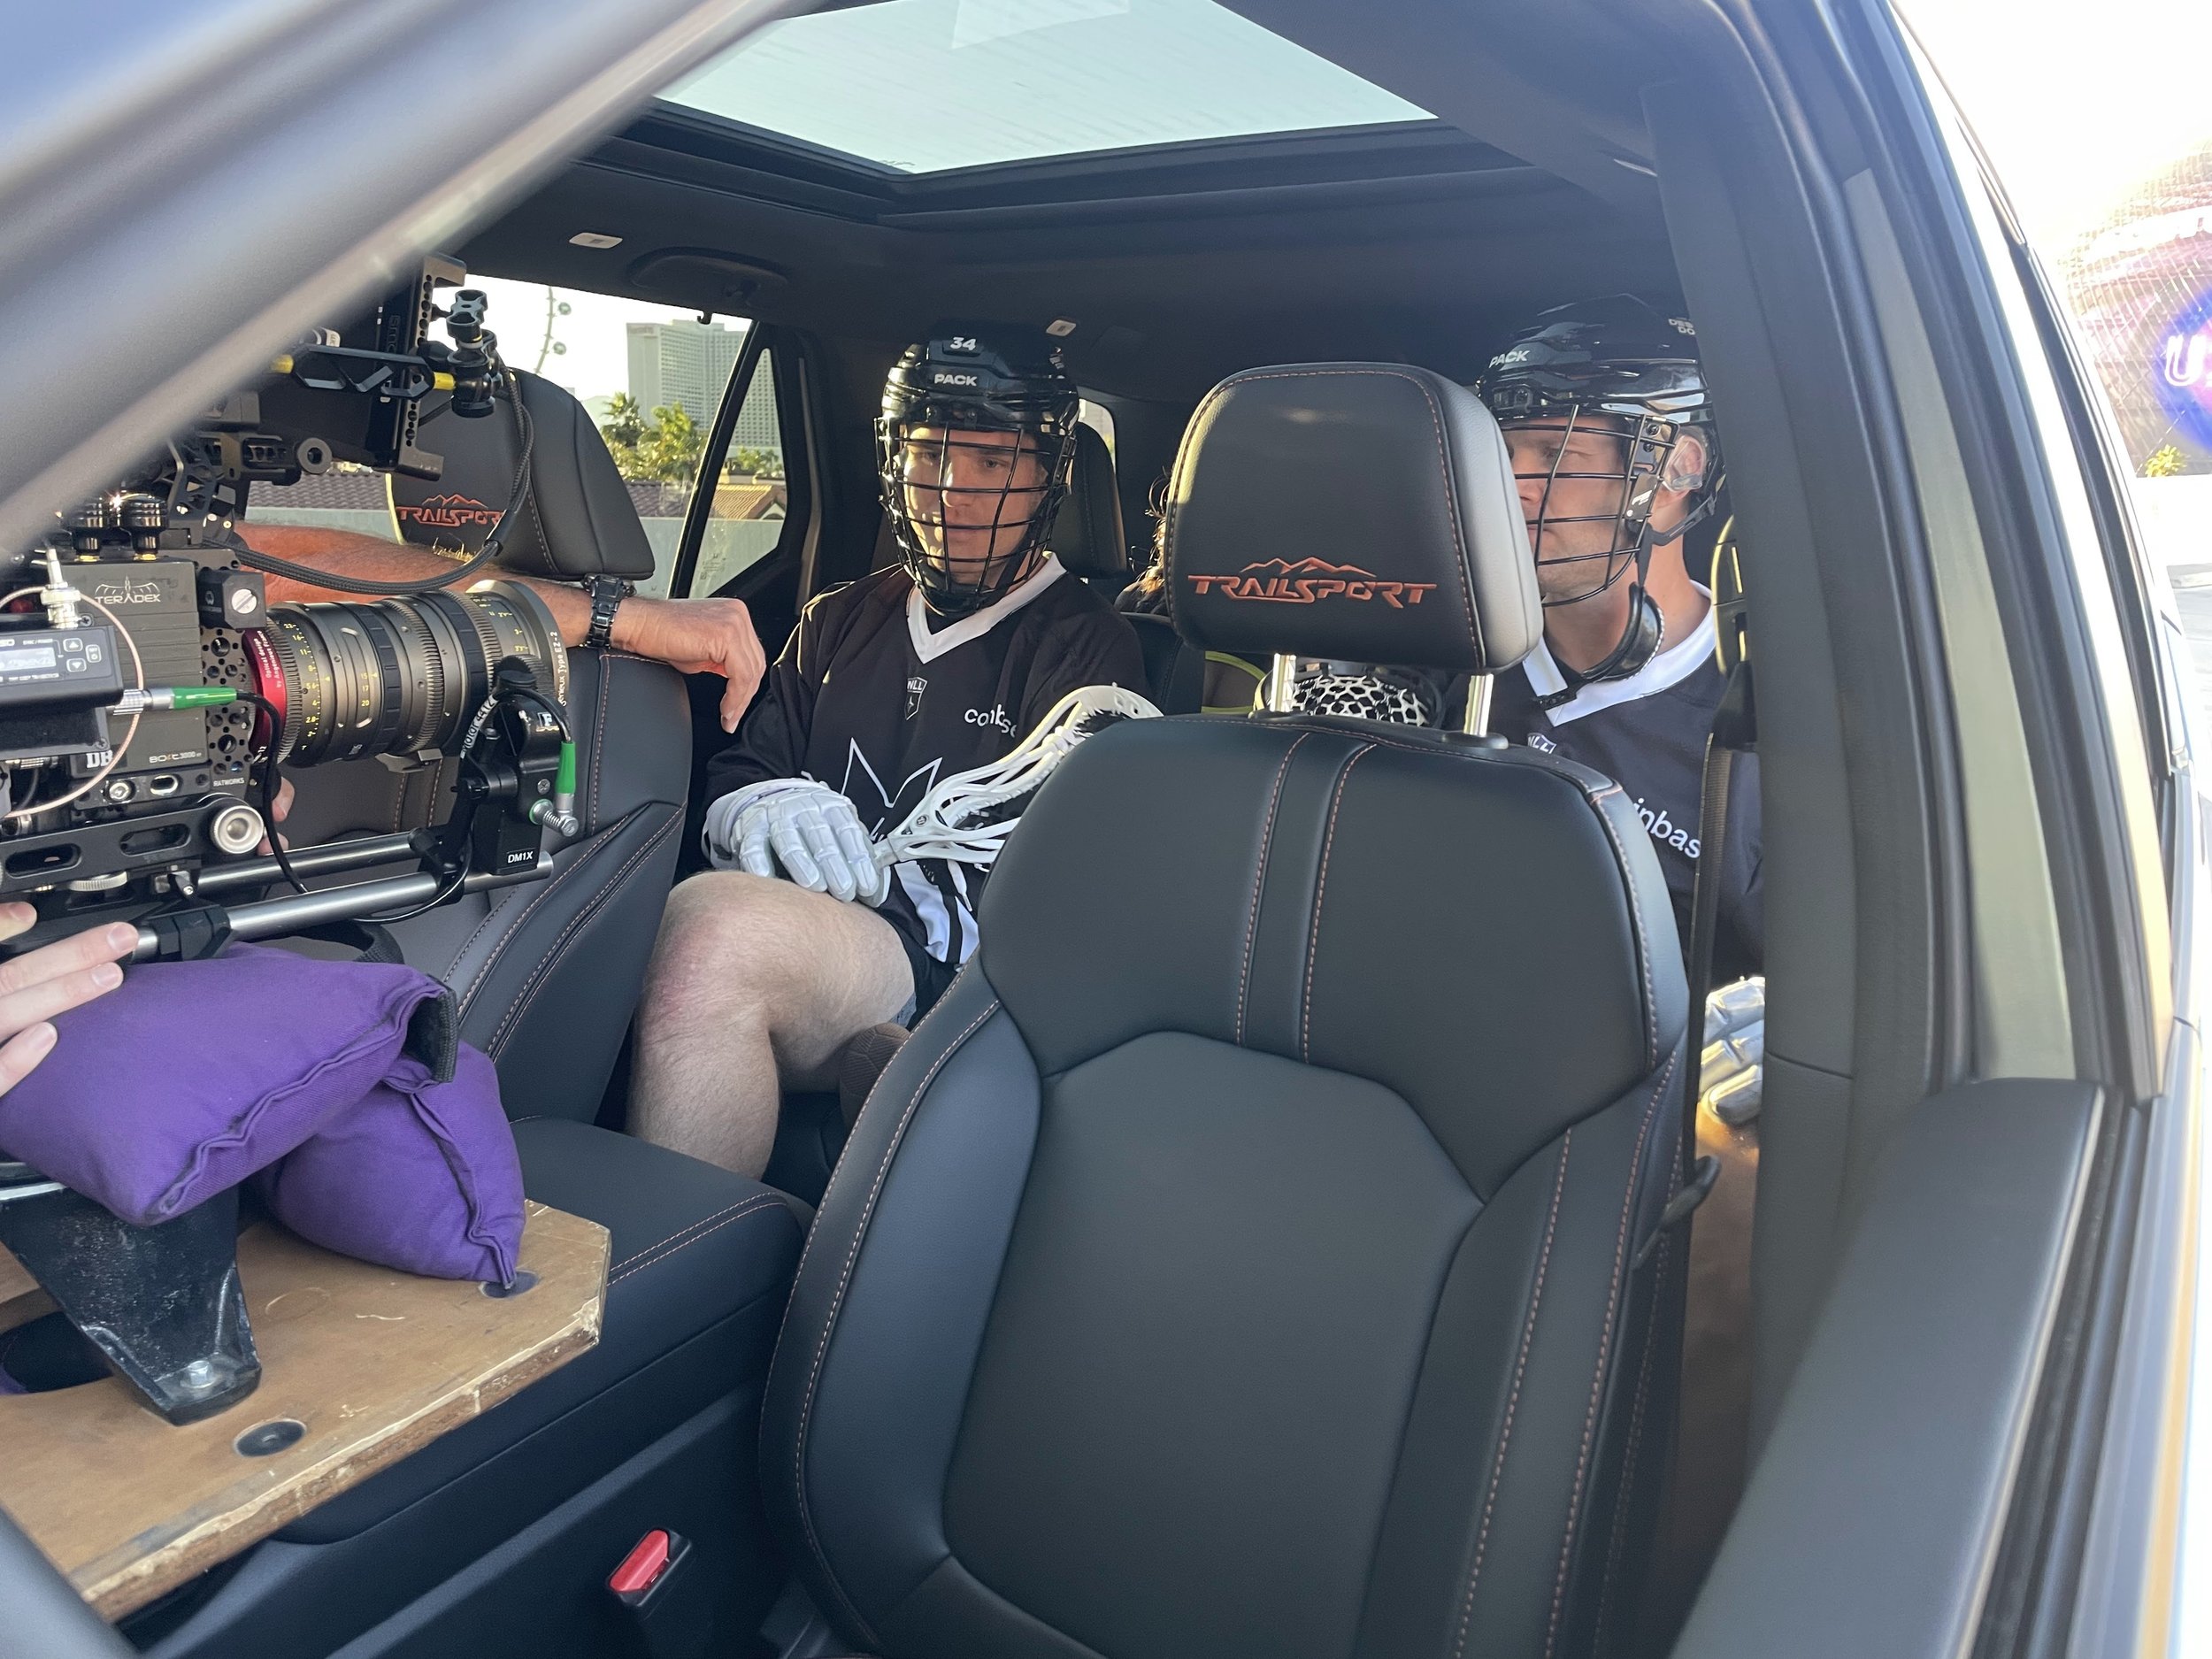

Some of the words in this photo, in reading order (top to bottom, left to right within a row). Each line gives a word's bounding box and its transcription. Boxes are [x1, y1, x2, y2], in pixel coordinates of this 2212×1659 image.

[950, 337, 976, 350] 34
[1488, 350, 1531, 368] PACK
[934, 373, 978, 386] PACK
[396, 506, 504, 527] TRAILSPOR
[1187, 575, 1438, 609] TRAILSPORT
[549, 631, 563, 653] EZ-2
[557, 654, 567, 673] Type
[507, 850, 534, 864] DM1X
